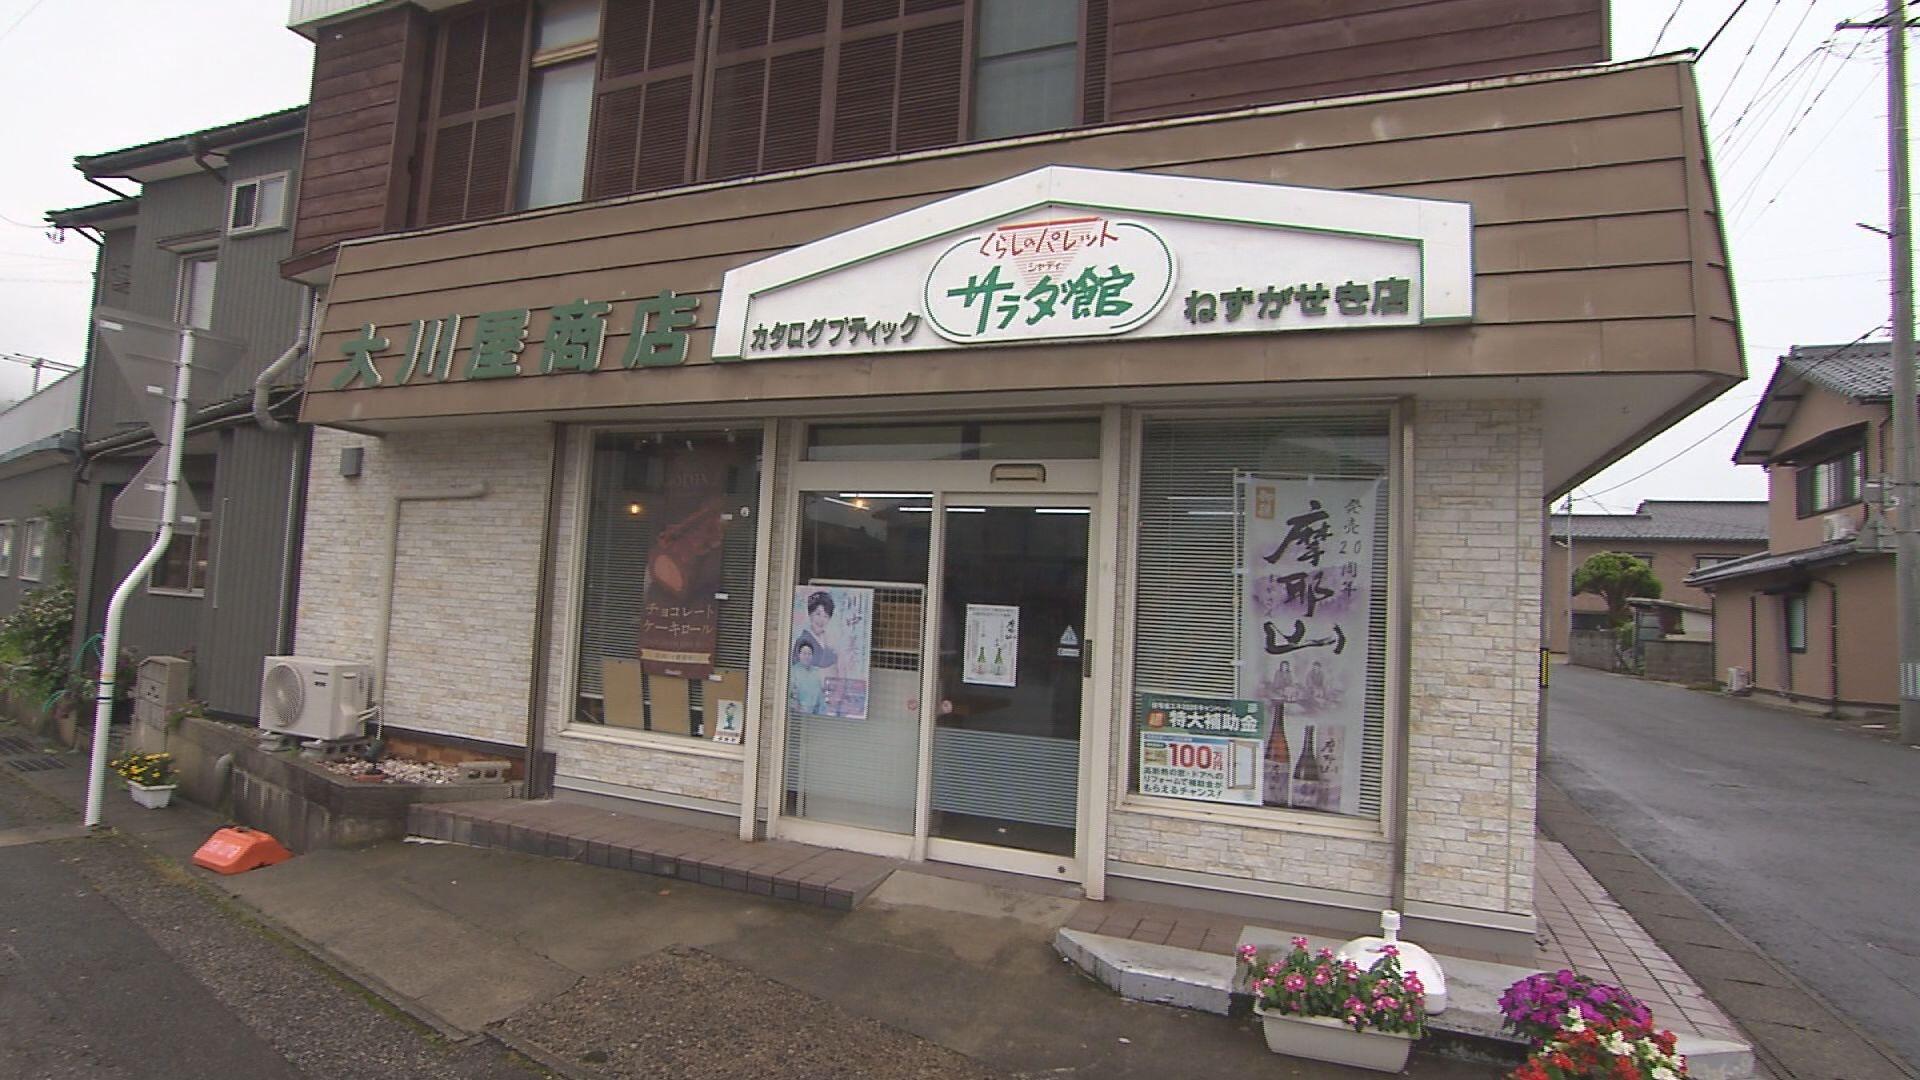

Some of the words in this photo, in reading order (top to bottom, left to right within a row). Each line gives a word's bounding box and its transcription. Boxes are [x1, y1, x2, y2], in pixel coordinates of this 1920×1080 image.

[979, 220, 1119, 259] くらしのパレット
[1026, 260, 1062, 273] シャディ
[947, 264, 1135, 336] サラダ館
[1183, 276, 1411, 325] ねずがせき店
[331, 288, 701, 390] 大川屋商店
[749, 311, 921, 352] カタログブティック
[643, 618, 713, 638] ケーキロール
[645, 602, 714, 619] チョコレート
[1168, 709, 1258, 732] 特大補助金
